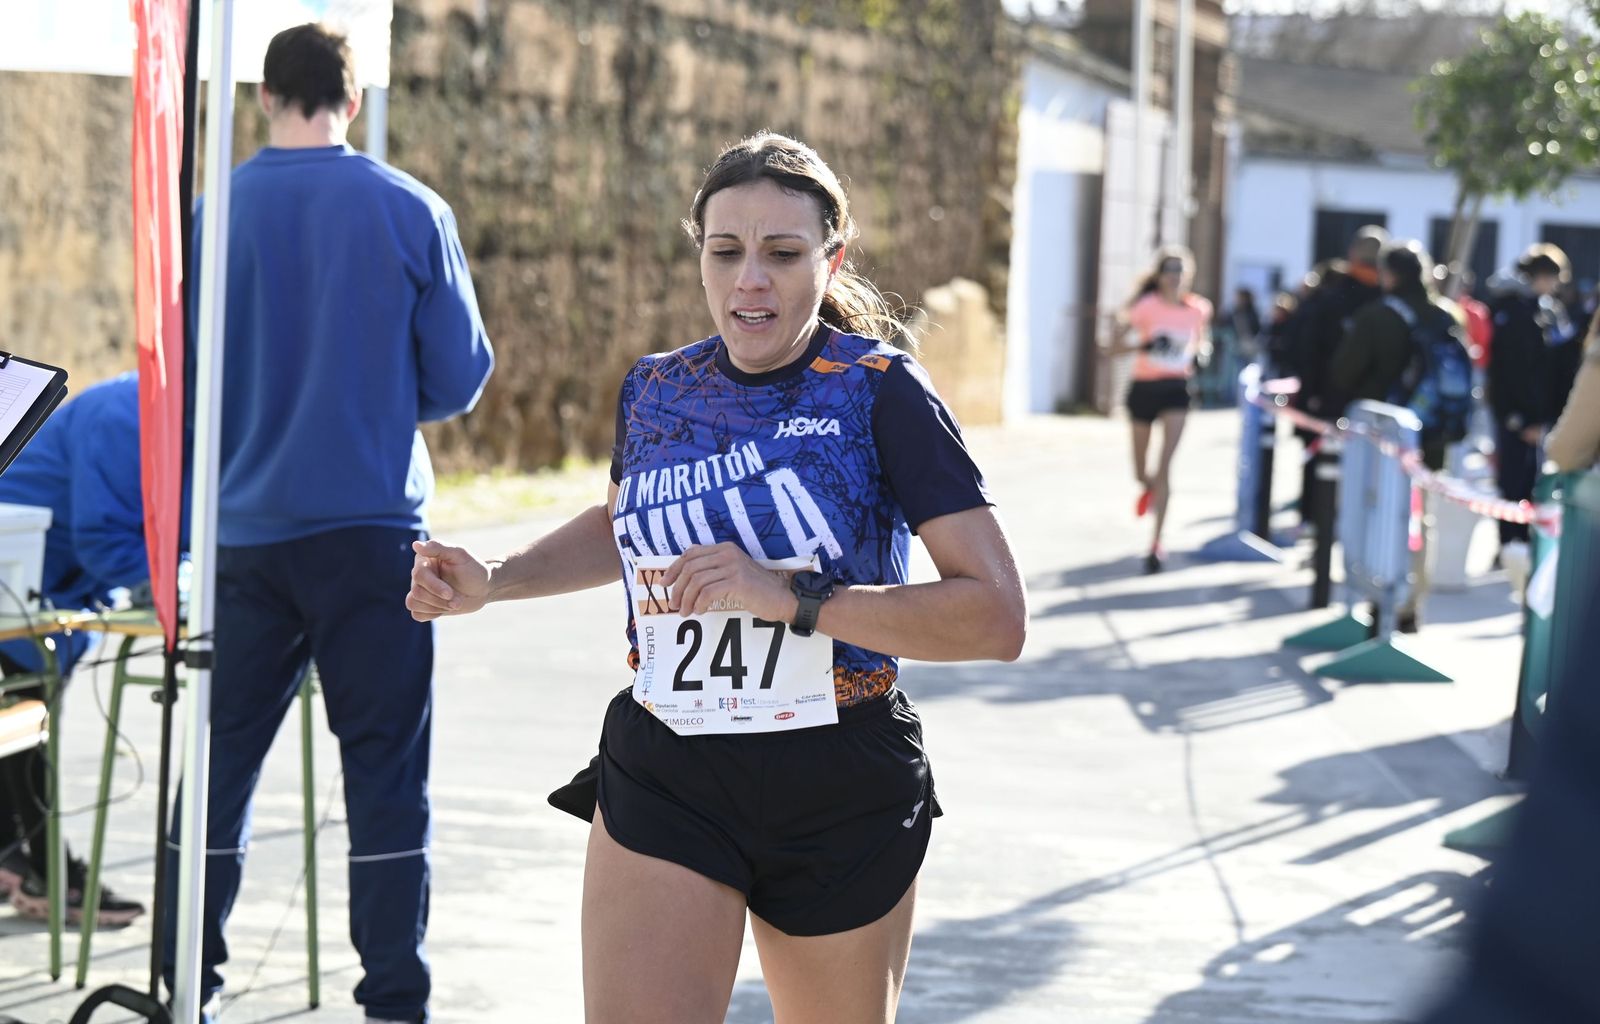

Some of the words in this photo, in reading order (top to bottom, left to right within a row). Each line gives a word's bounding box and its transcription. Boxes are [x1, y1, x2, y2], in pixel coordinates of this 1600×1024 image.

[773, 417, 841, 439] HOKA
[636, 440, 765, 508] MARATÓN
[672, 617, 786, 692] 247
[669, 717, 704, 726] IMDECO
